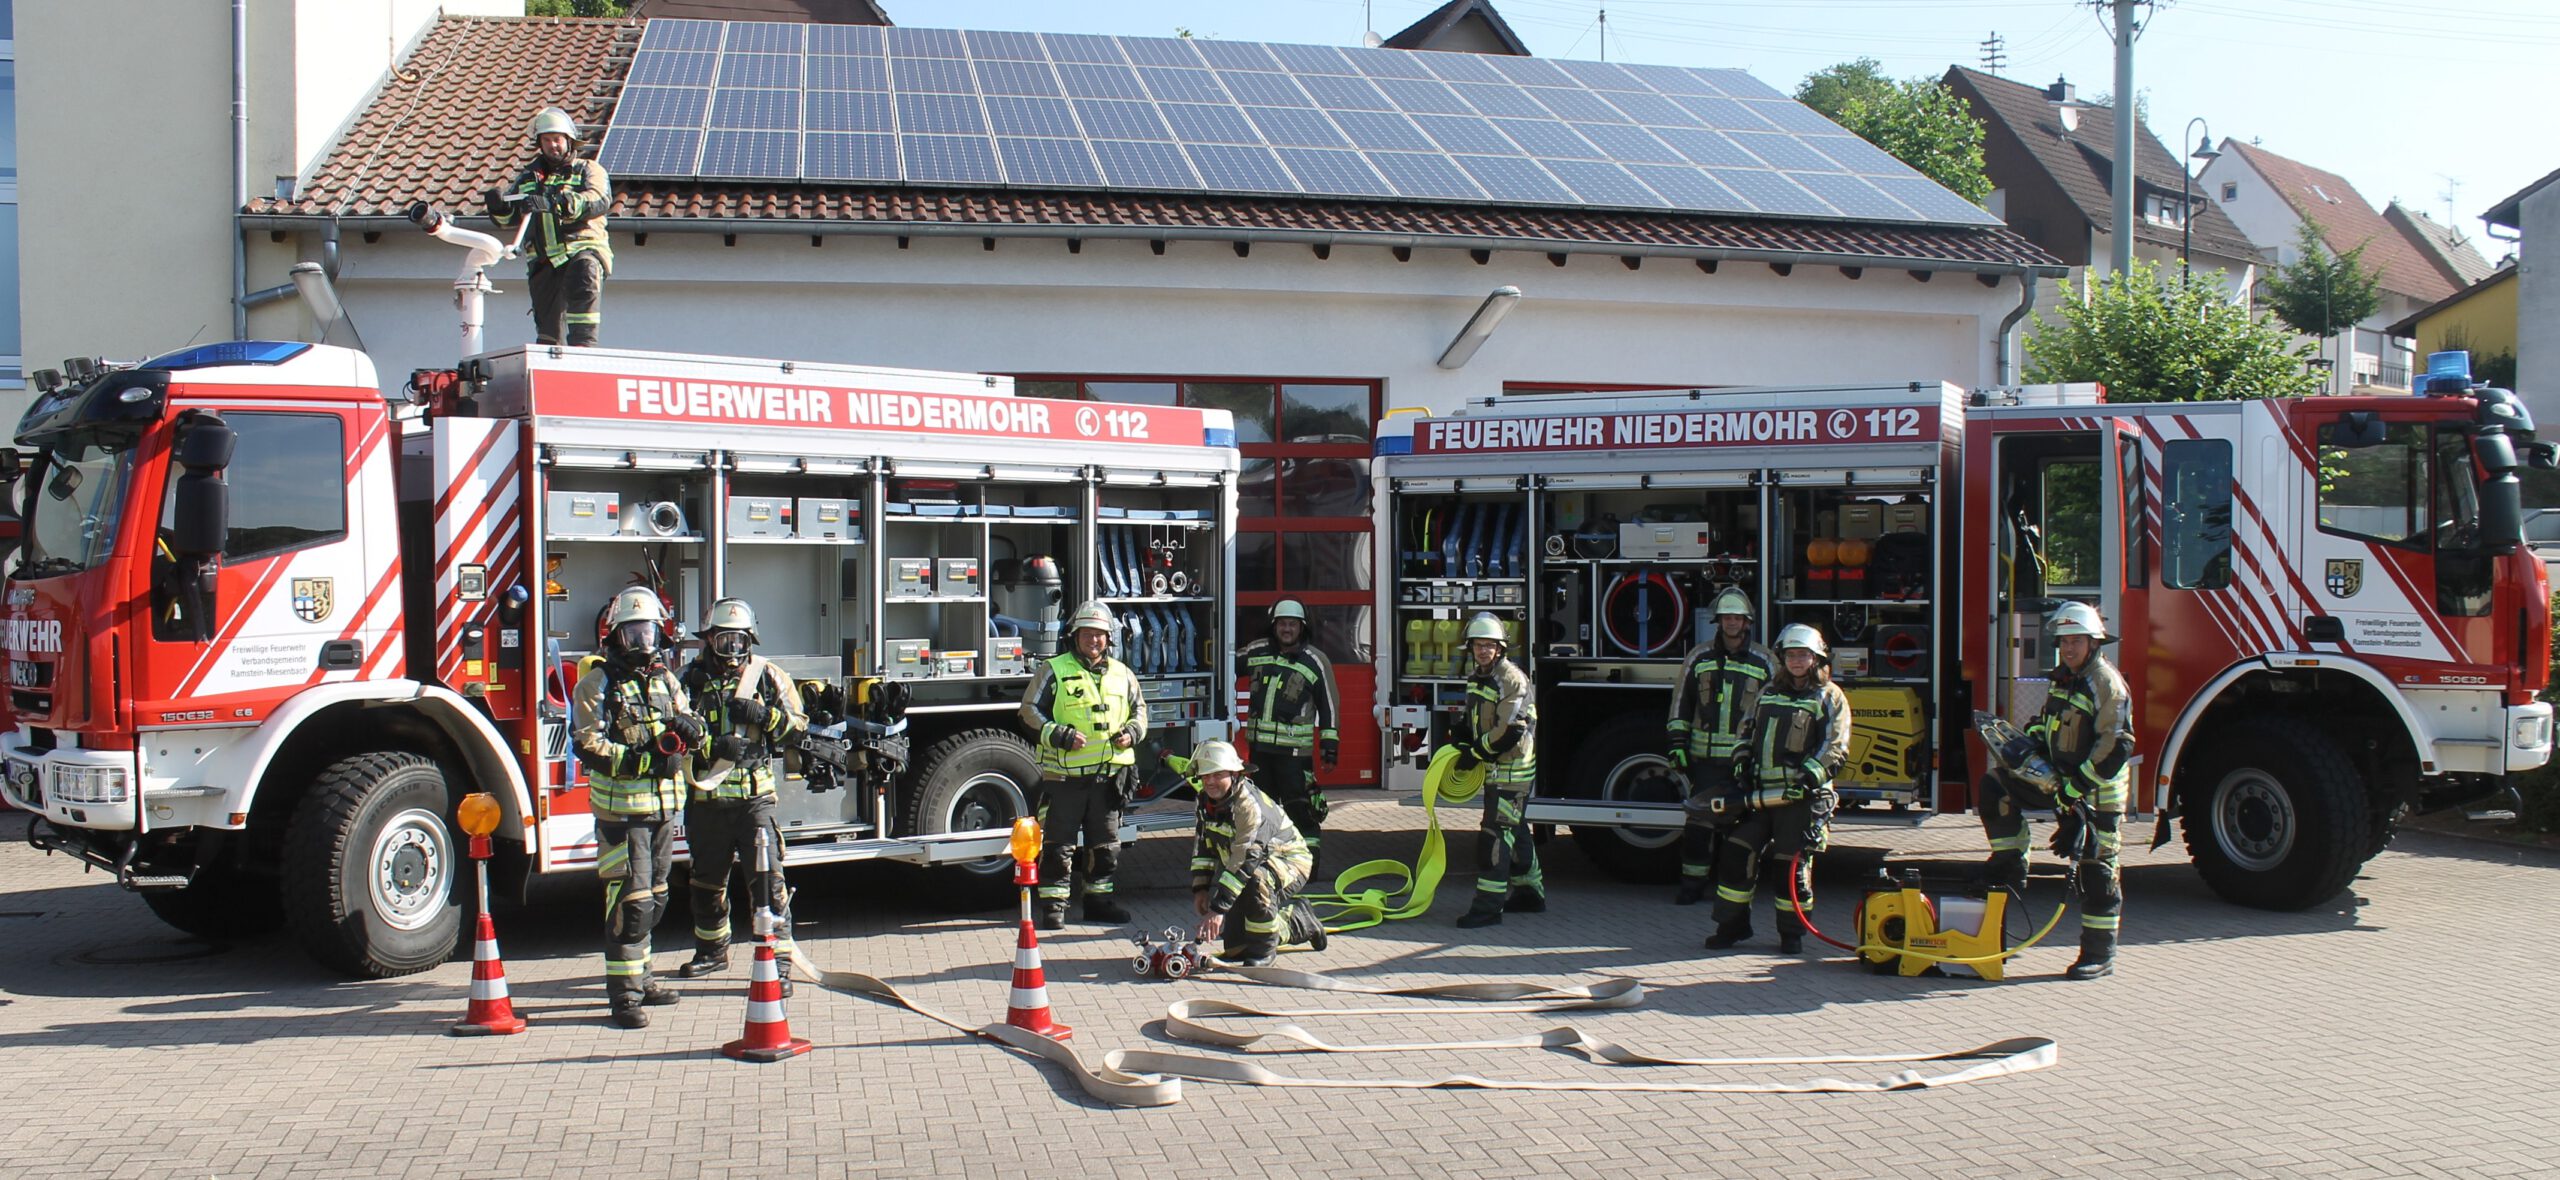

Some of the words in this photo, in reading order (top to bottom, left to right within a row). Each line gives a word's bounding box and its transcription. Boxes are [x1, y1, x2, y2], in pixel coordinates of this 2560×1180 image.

[616, 378, 832, 423] FEUERWEHR
[848, 391, 1051, 434] NIEDERMOHR
[1104, 409, 1149, 438] 112
[1429, 418, 1604, 450] FEUERWEHR
[1614, 411, 1817, 444] NIEDERMOHR
[1864, 408, 1920, 437] 112
[632, 598, 641, 610] A
[728, 605, 737, 617] A
[2356, 618, 2387, 628] Freiwillige
[2389, 619, 2422, 628] Feuerwehr
[2363, 629, 2421, 638] Verbandsgemeinde
[2353, 639, 2421, 648] Ramstein-Miesenbach
[232, 646, 268, 654] Freiwillige
[270, 644, 306, 652] Feuerwehr
[241, 655, 307, 666] Verbandsgemeinde
[231, 668, 308, 678] Ramstein-Miesenbach
[2439, 675, 2487, 684] 150E30
[160, 710, 214, 722] 150E32
[235, 708, 253, 717] E6
[1851, 708, 1888, 718] ENDRESS
